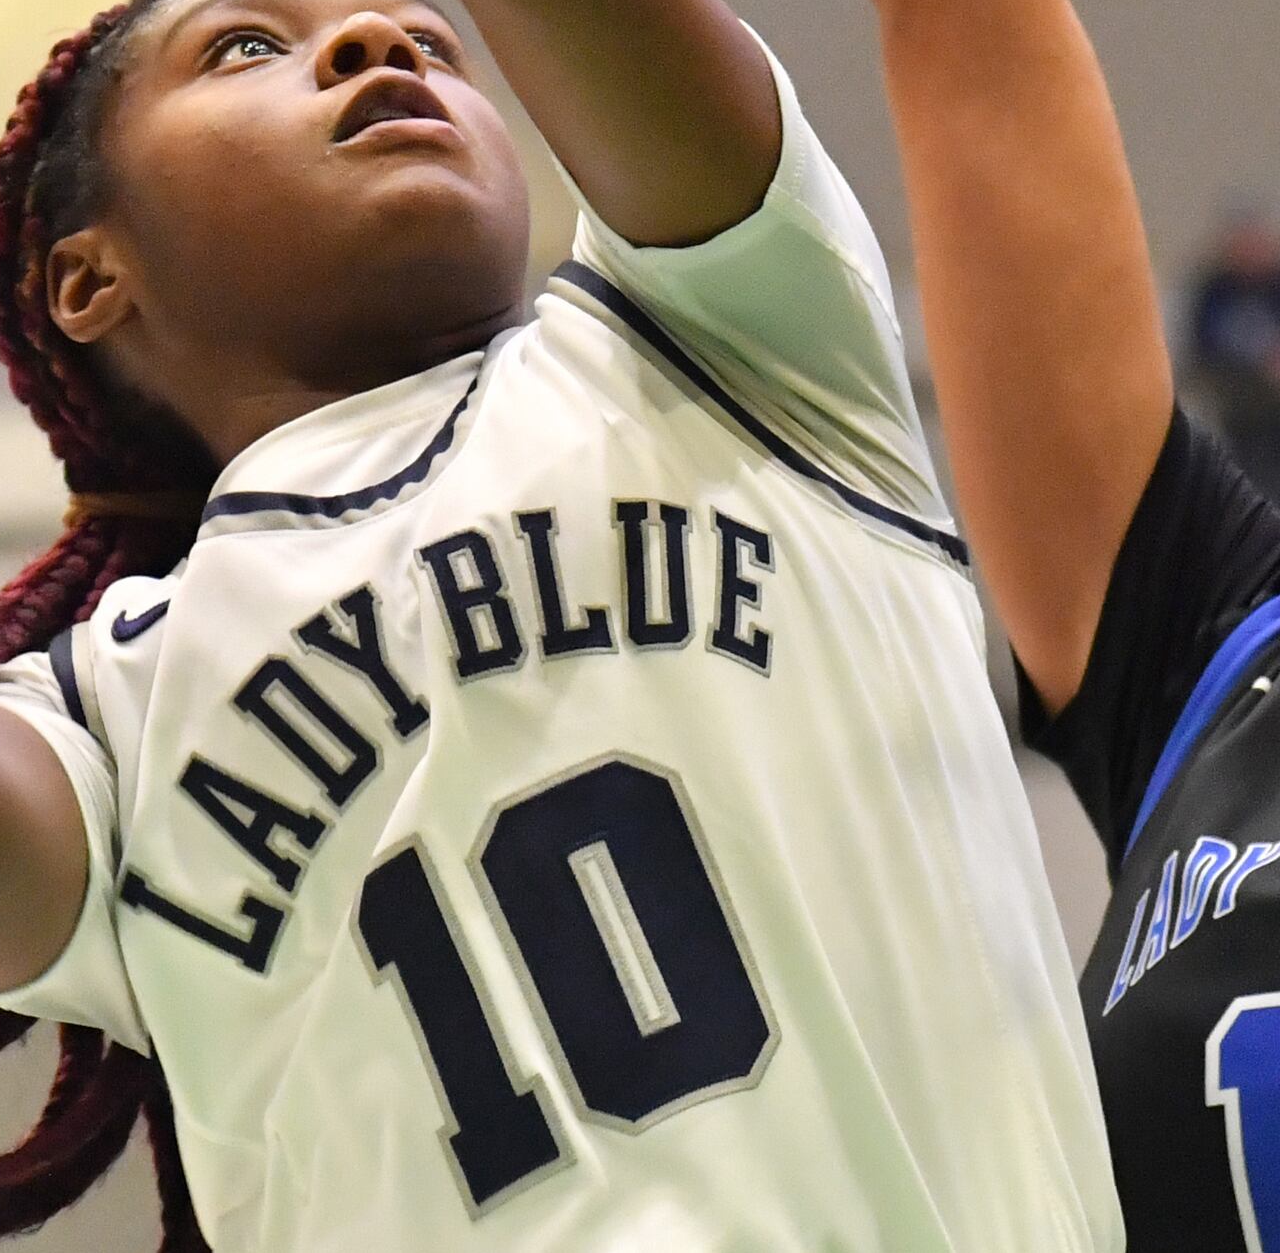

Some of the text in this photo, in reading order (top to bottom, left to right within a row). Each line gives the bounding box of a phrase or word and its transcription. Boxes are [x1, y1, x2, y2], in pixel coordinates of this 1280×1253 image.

[118, 498, 775, 977] LADY BLUE
[349, 749, 783, 1221] 10
